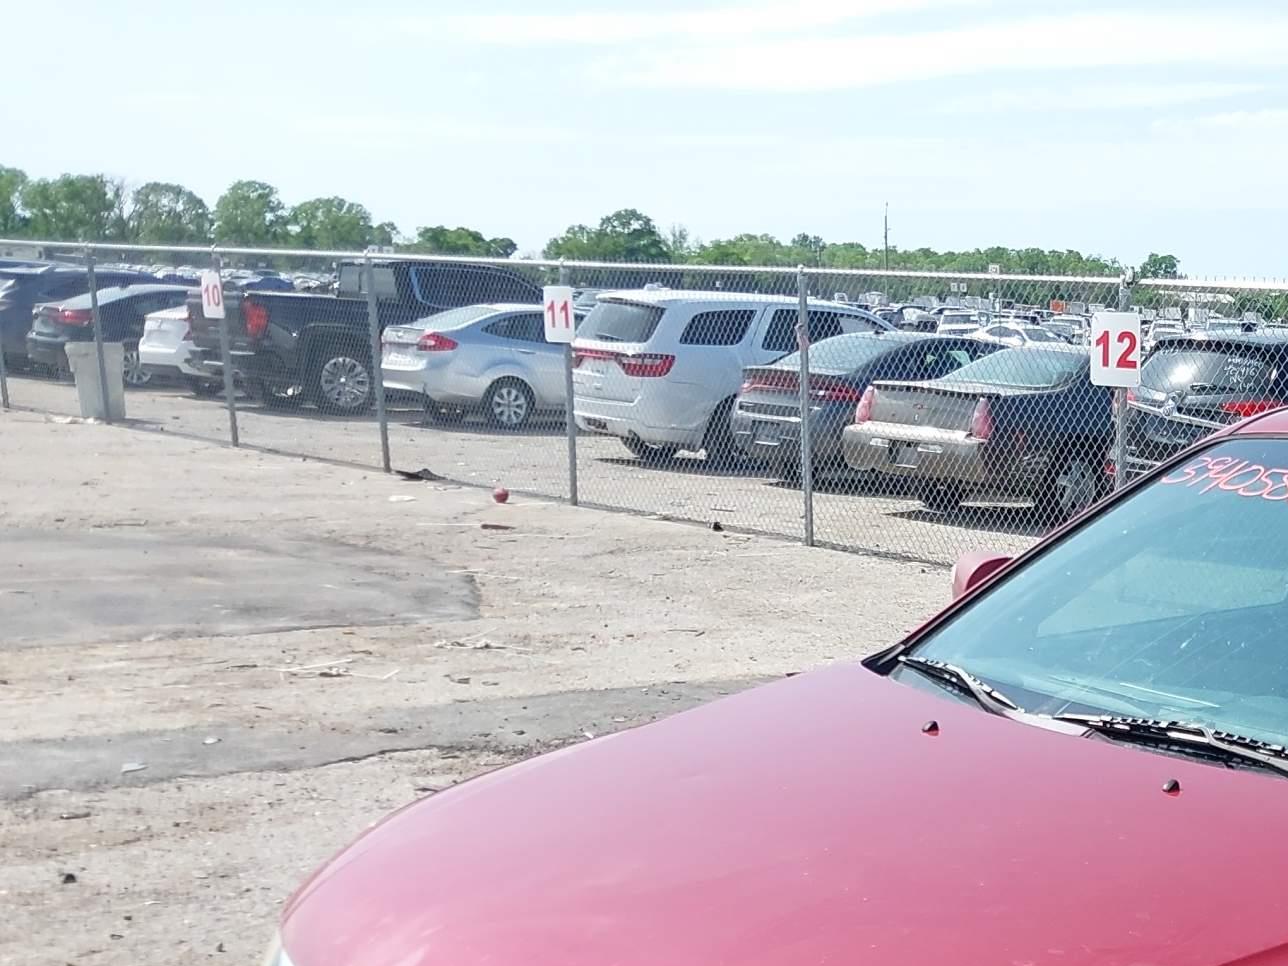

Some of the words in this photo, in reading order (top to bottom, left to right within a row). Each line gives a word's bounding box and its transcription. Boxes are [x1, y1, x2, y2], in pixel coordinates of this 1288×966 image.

[203, 284, 220, 306] 10
[547, 300, 570, 329] 11
[1095, 330, 1137, 369] 12
